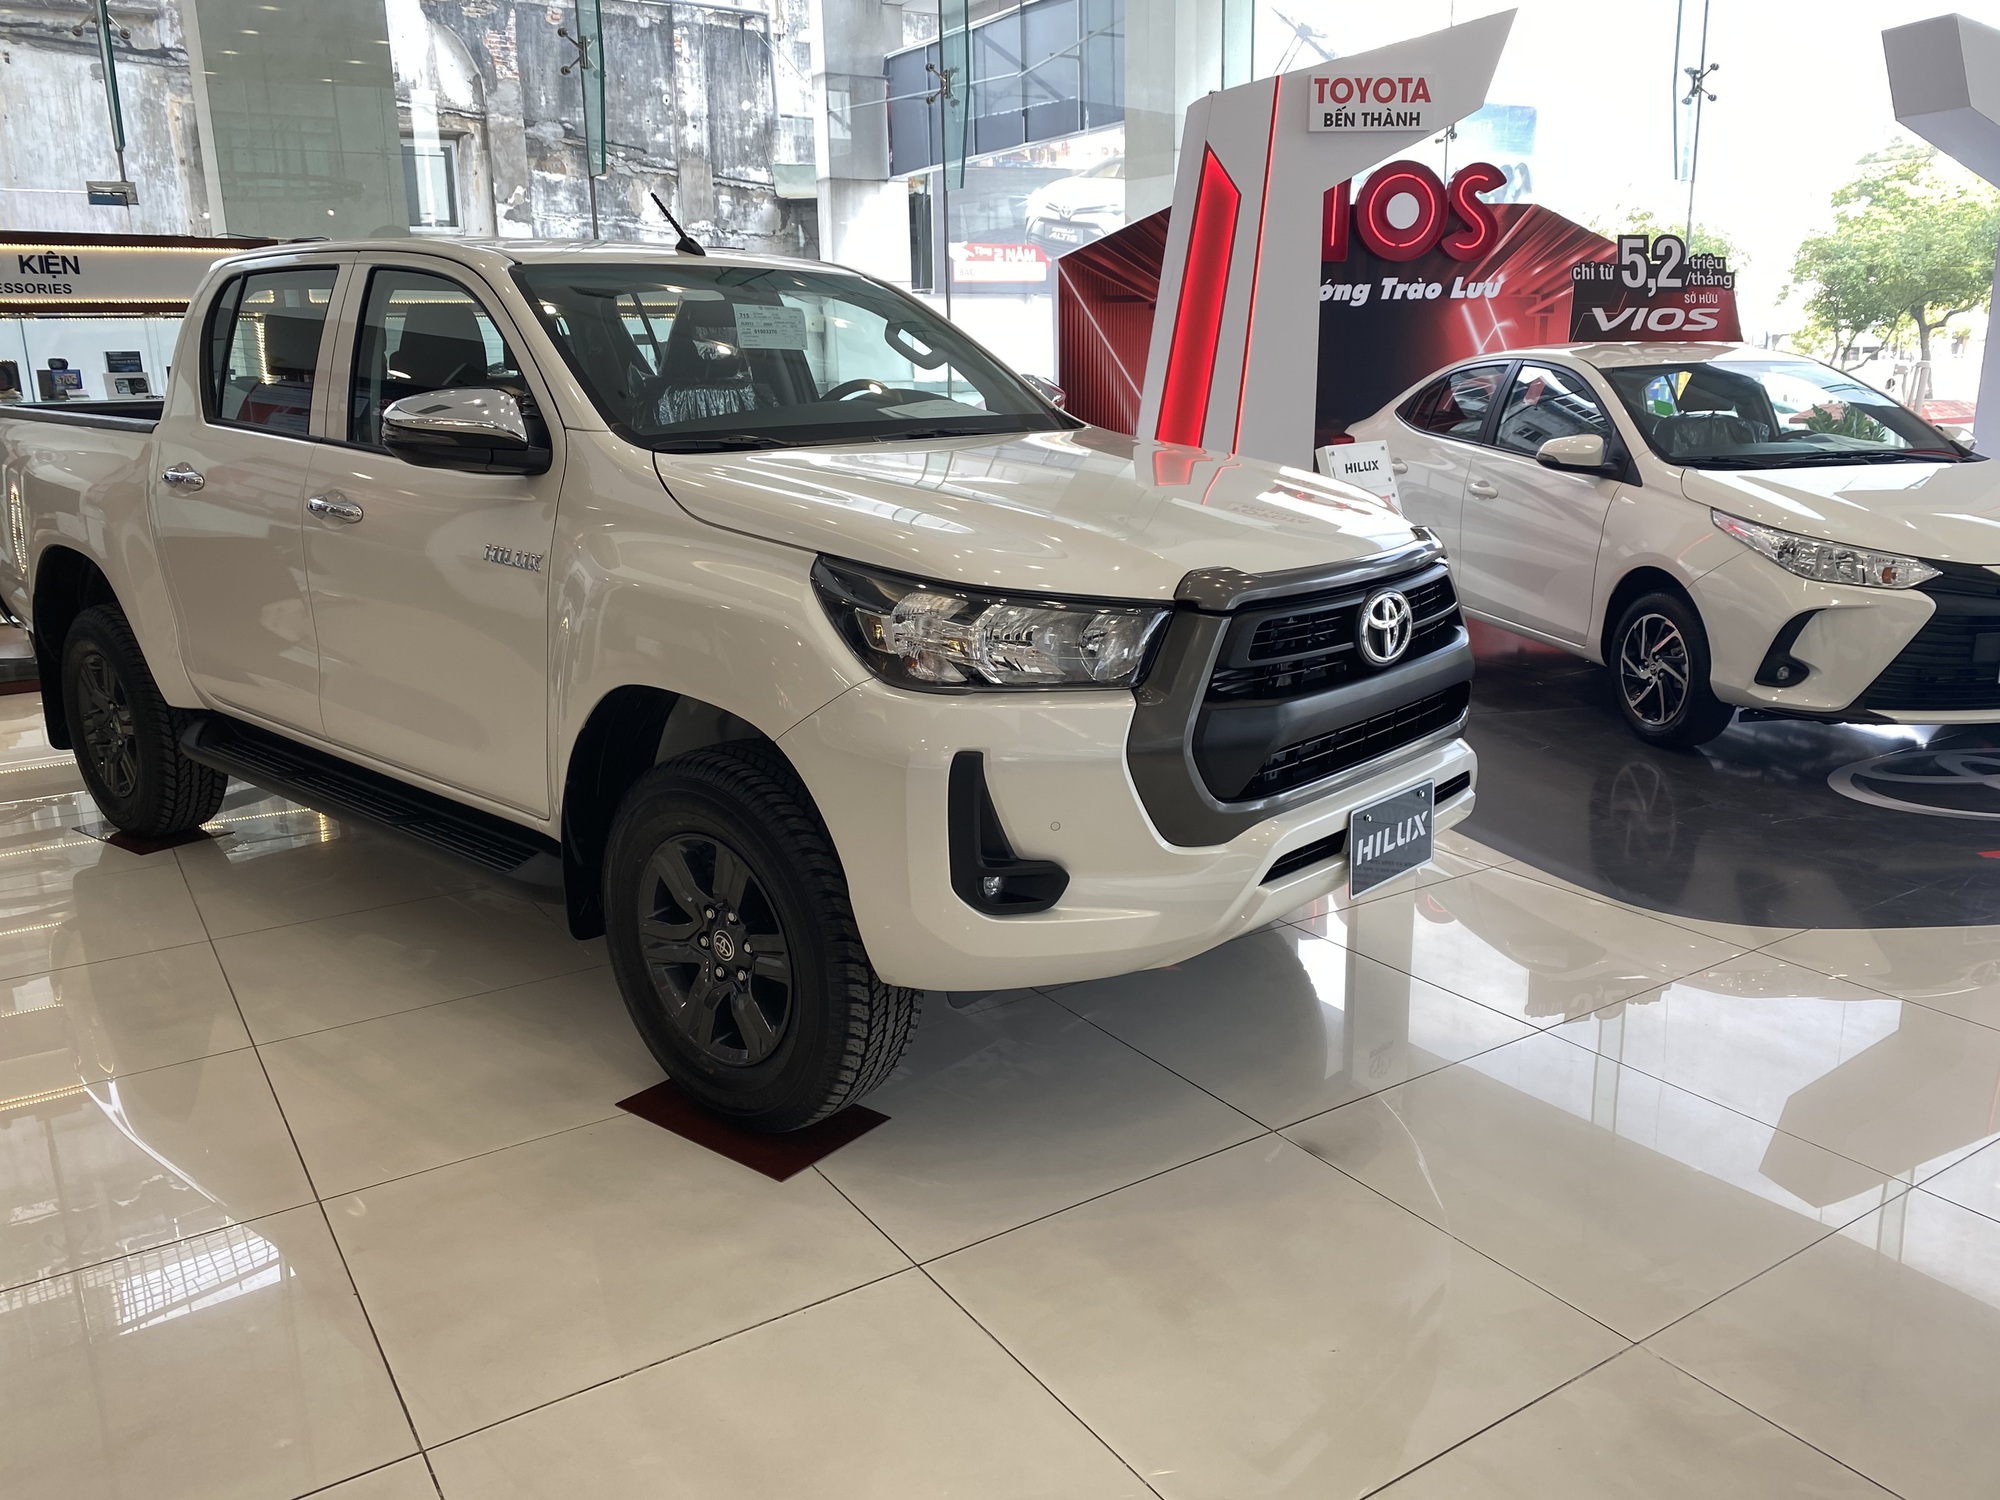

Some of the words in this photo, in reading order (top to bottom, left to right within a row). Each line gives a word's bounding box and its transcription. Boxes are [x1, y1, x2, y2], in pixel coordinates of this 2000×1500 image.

[1314, 77, 1431, 104] TOYOTA
[1323, 105, 1355, 127] BẾN
[1361, 107, 1421, 127] THÀNH
[17, 250, 81, 279] KIỆN
[1573, 263, 1594, 280] chỉ
[1599, 264, 1615, 281] từ
[1621, 238, 1682, 297] 5,2
[1691, 256, 1724, 271] triệu
[1381, 276, 1443, 300] Trào
[1684, 291, 1697, 305] SỞ
[1699, 292, 1718, 304] HỮU
[1591, 307, 1721, 332] VIOS
[1345, 459, 1379, 474] HILUX
[483, 543, 544, 573] HILUX
[1356, 810, 1429, 867] HILUX
